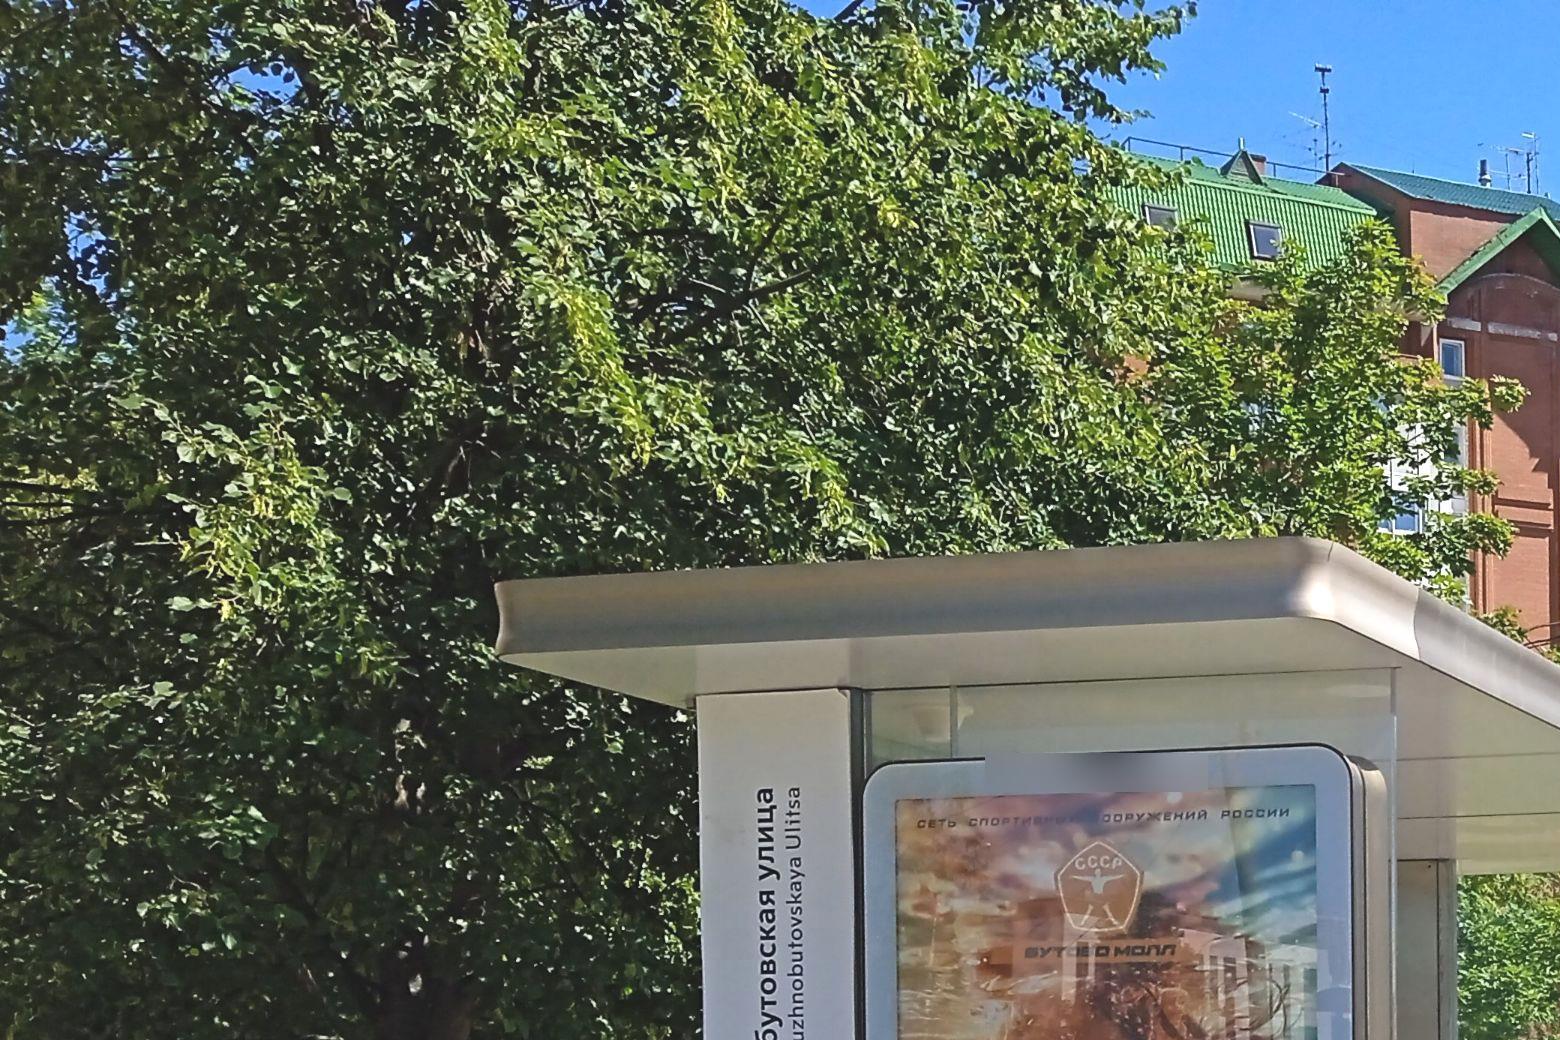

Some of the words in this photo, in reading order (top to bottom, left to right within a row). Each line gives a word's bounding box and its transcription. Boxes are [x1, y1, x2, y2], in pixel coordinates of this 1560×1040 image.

[756, 787, 781, 881] улица
[784, 786, 802, 849] Ulitsa
[916, 817, 957, 829] СЕТЬ
[1101, 808, 1208, 823] ООРУЖЕНИЙ
[1220, 807, 1290, 820] РОССИИ
[1074, 855, 1123, 870] СССР
